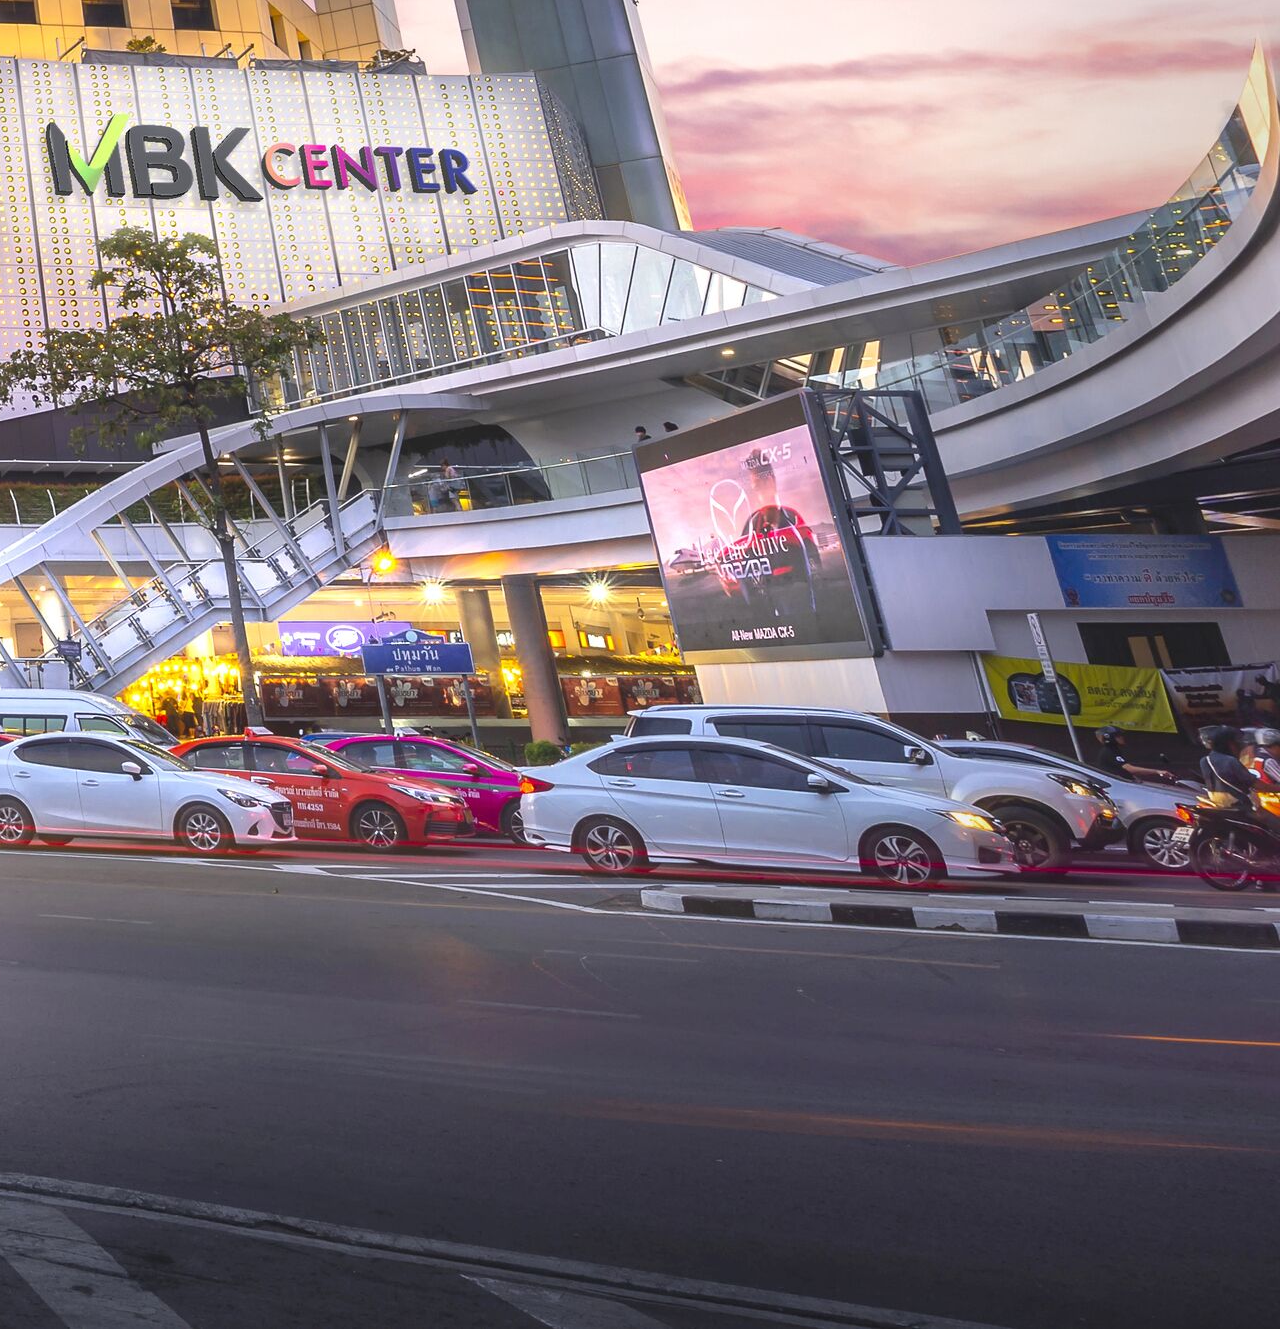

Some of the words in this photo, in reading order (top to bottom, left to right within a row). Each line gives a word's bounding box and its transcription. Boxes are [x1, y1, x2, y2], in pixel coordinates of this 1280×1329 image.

[46, 112, 265, 202] MBK
[261, 142, 478, 195] CENTER
[760, 442, 791, 465] CX-5
[751, 528, 789, 557] drive
[753, 626, 778, 640] MAZDA
[777, 625, 795, 638] CX-5
[392, 645, 439, 665] ปทุมวัน
[307, 803, 324, 812] 4353
